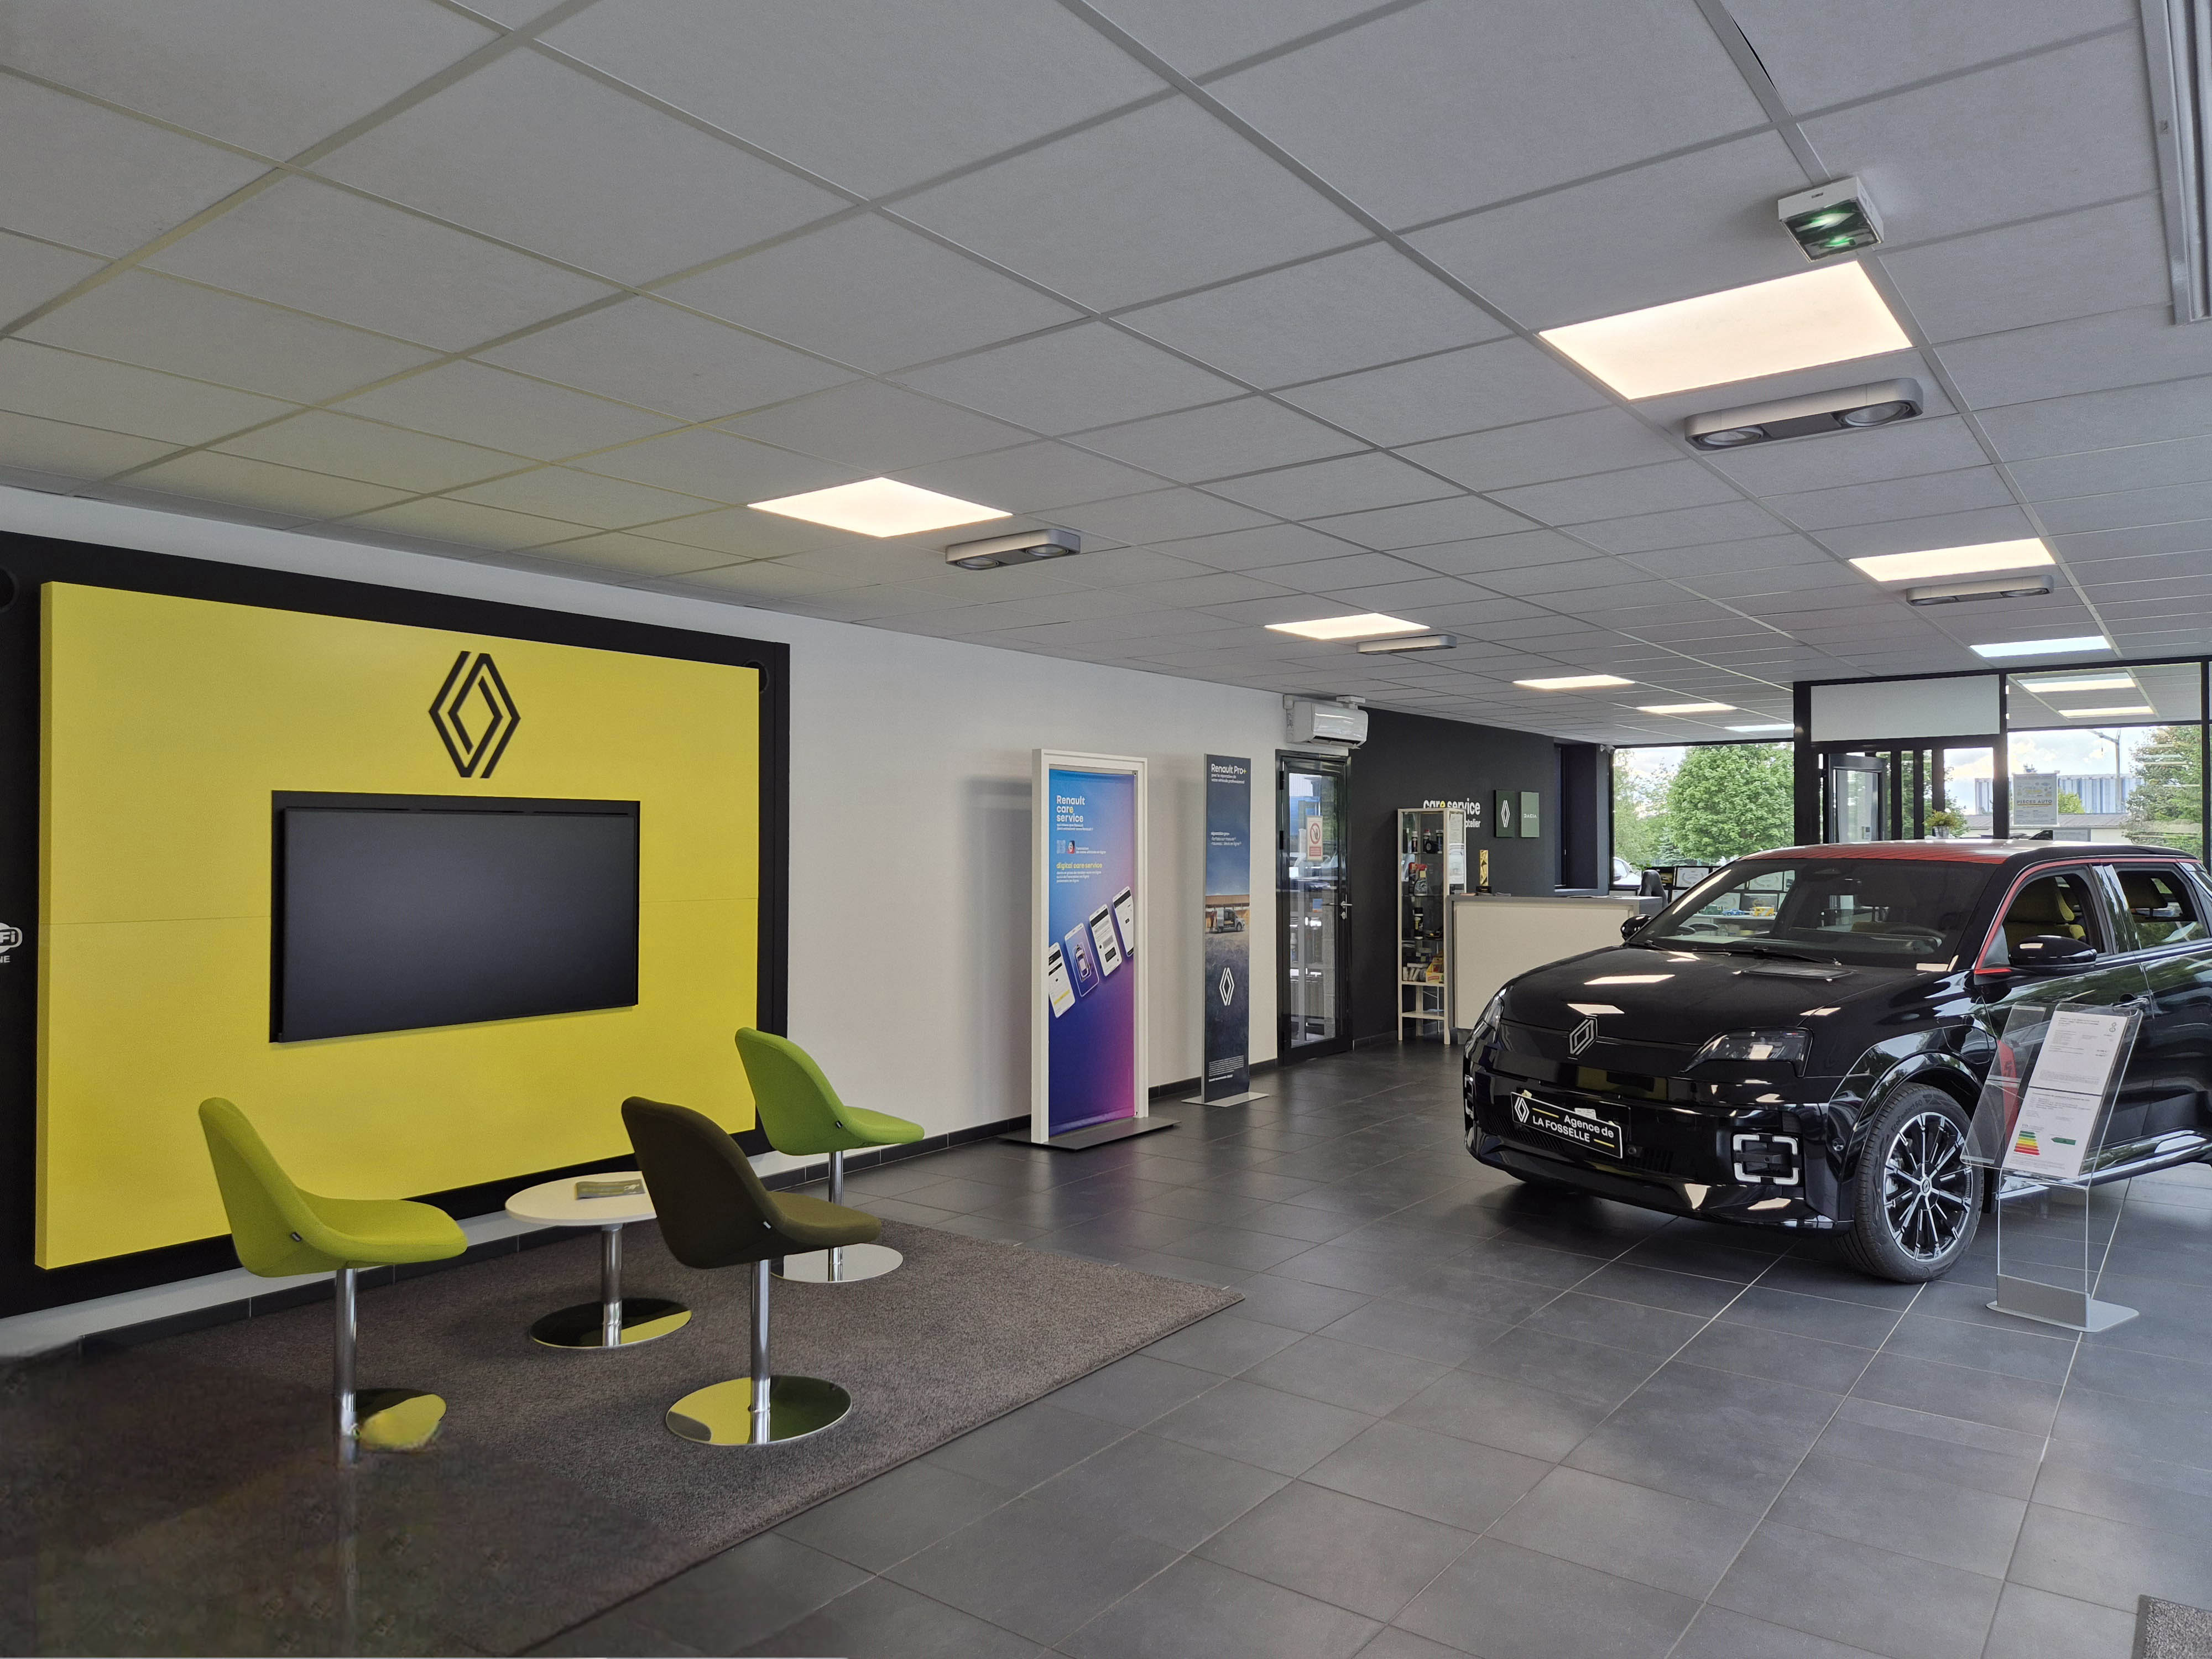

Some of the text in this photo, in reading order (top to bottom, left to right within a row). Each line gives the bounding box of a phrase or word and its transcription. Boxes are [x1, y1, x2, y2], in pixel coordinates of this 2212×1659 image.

[1211, 764, 1248, 774] Renault Pro+
[1057, 795, 1085, 805] Renault
[1447, 797, 1481, 815] service
[1057, 813, 1084, 822] service
[1532, 1115, 1590, 1142] LA FOSSELLE
[1564, 1114, 1600, 1134] Agence
[1601, 1126, 1614, 1139] de
